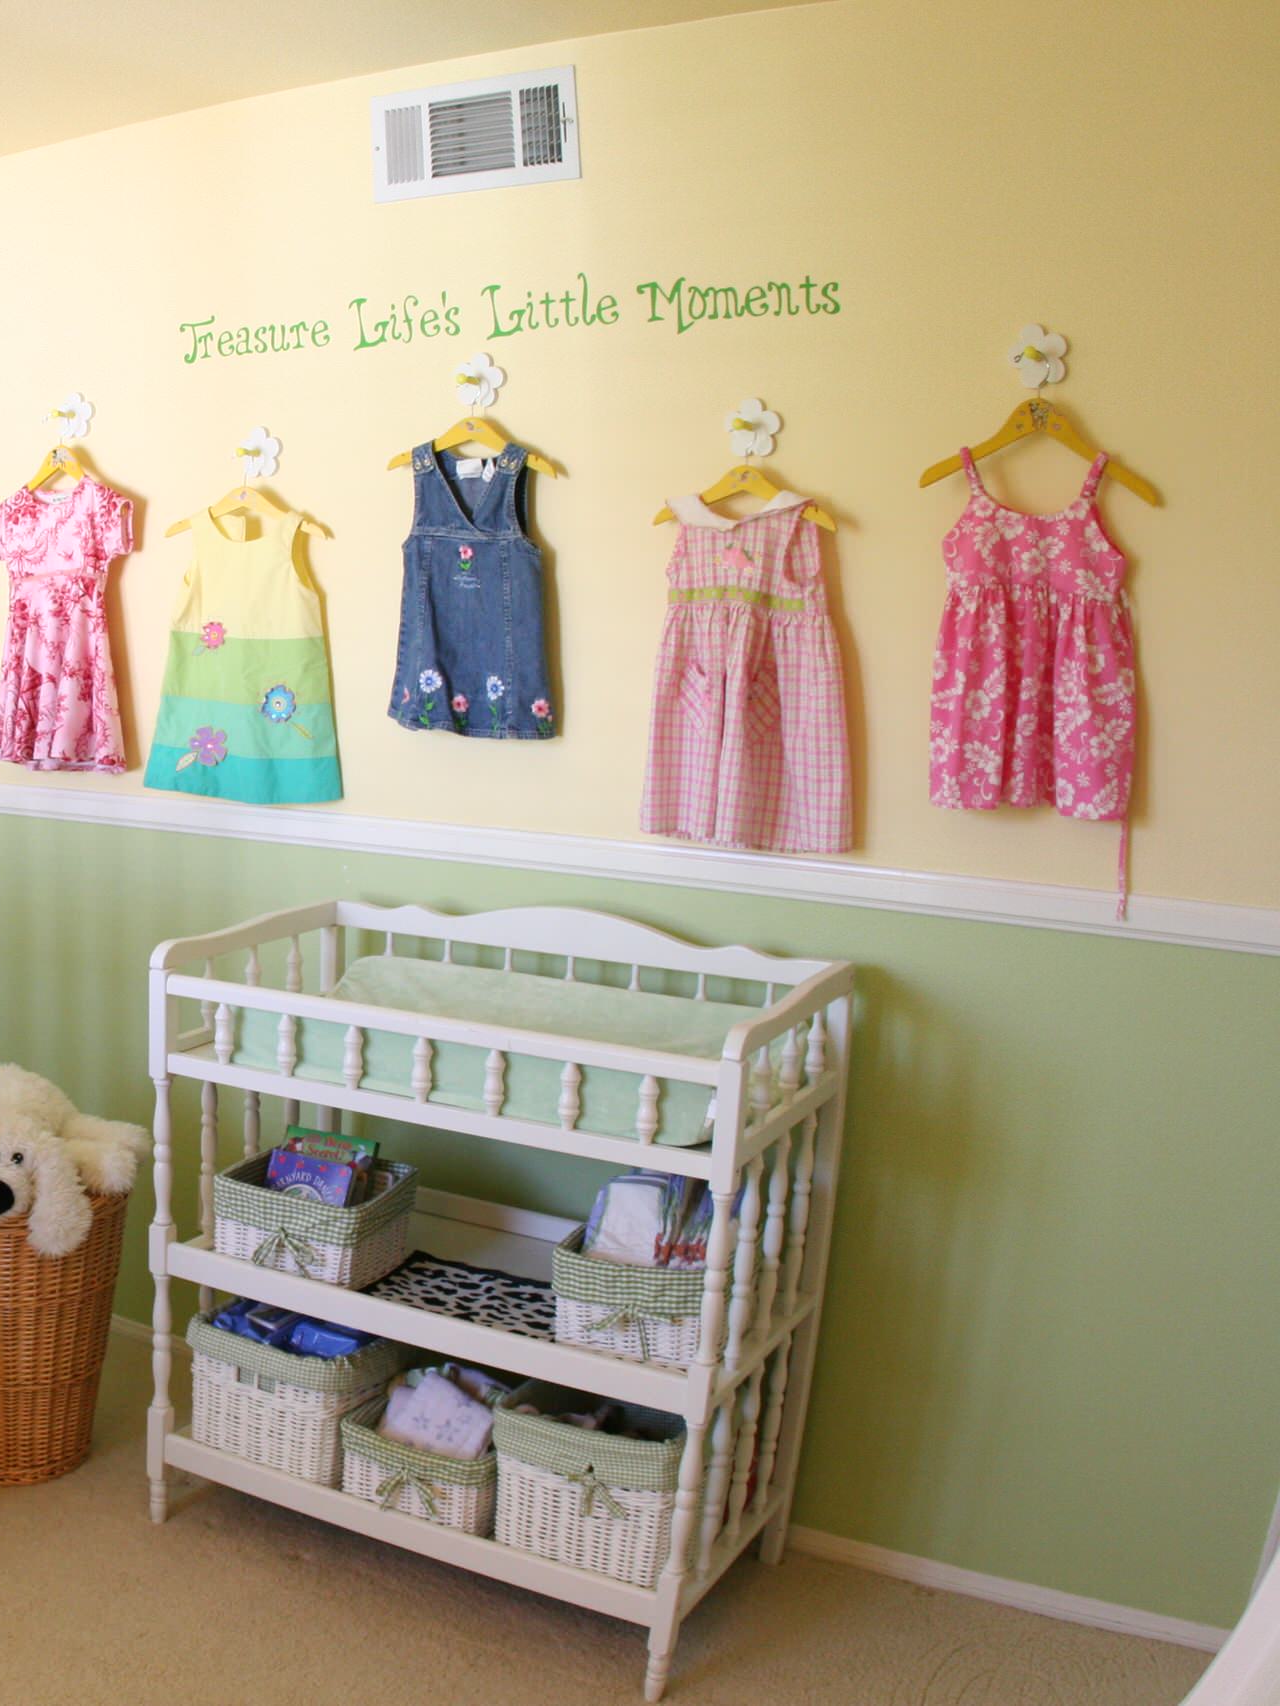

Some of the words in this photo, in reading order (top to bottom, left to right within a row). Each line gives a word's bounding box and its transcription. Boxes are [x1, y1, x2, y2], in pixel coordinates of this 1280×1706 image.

[179, 315, 332, 364] Treasure
[348, 291, 463, 352] Life's
[481, 272, 621, 341] Little
[636, 274, 843, 336] Moments
